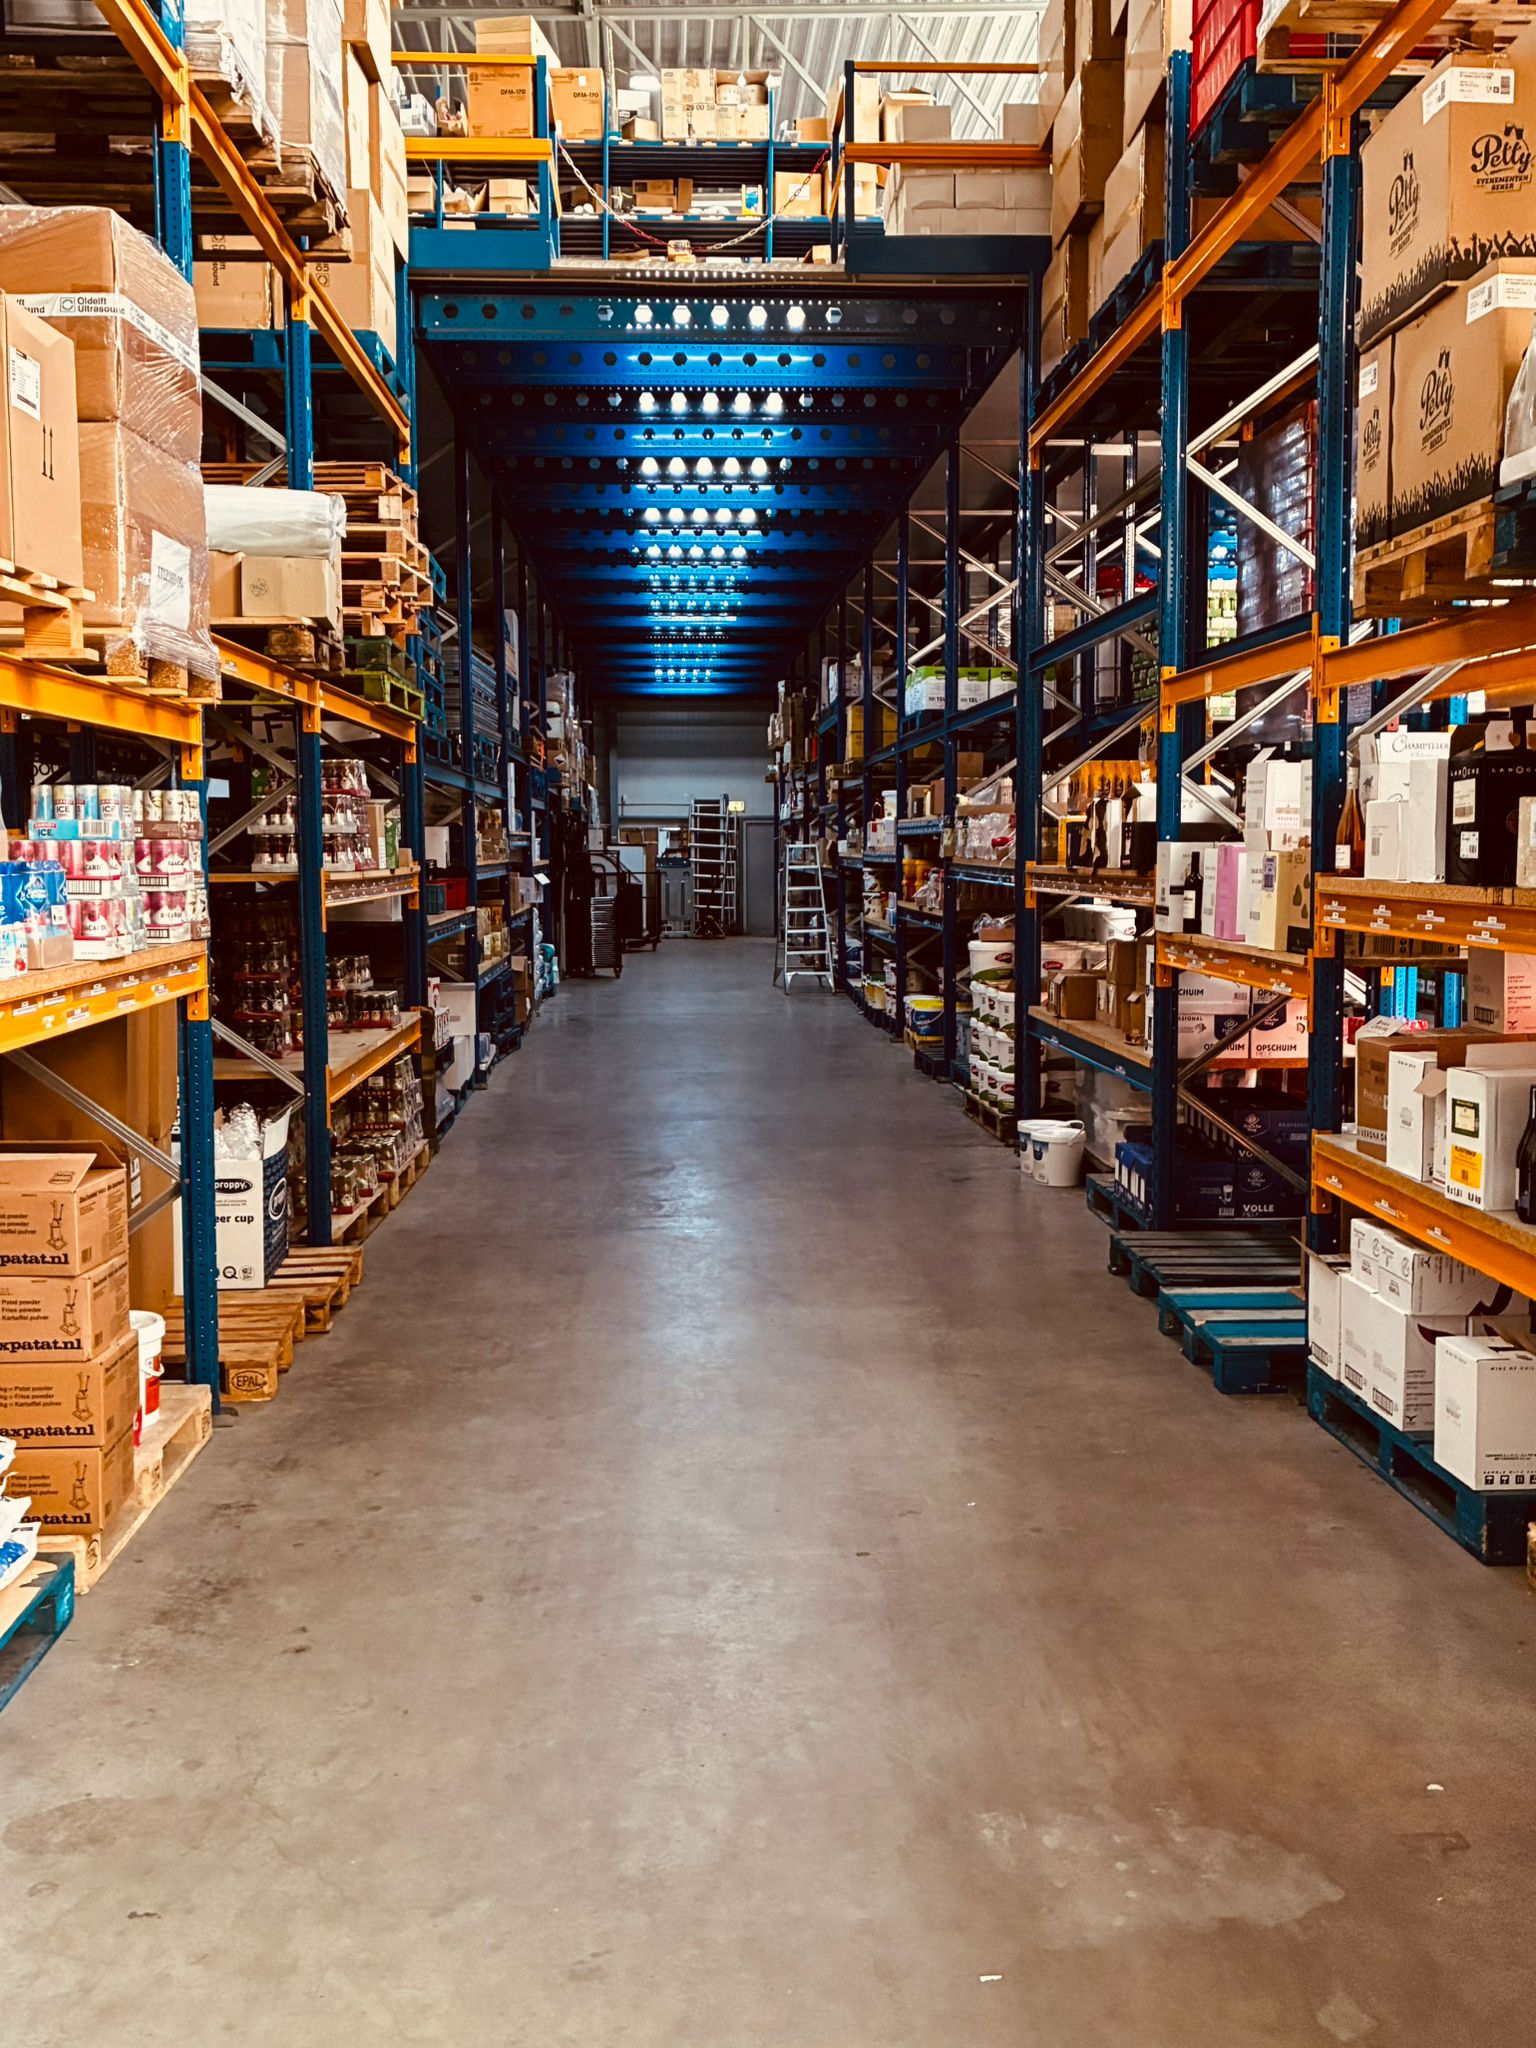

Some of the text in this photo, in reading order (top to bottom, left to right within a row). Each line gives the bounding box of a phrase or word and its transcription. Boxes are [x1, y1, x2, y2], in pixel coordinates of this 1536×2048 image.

[1471, 134, 1534, 174] Petty
[77, 296, 107, 305] Oldelft
[1256, 1044, 1297, 1052] OPSCHUIM
[1243, 1204, 1275, 1212] VOLLE
[216, 1214, 255, 1229] eer cup
[236, 1377, 261, 1387] EPAL
